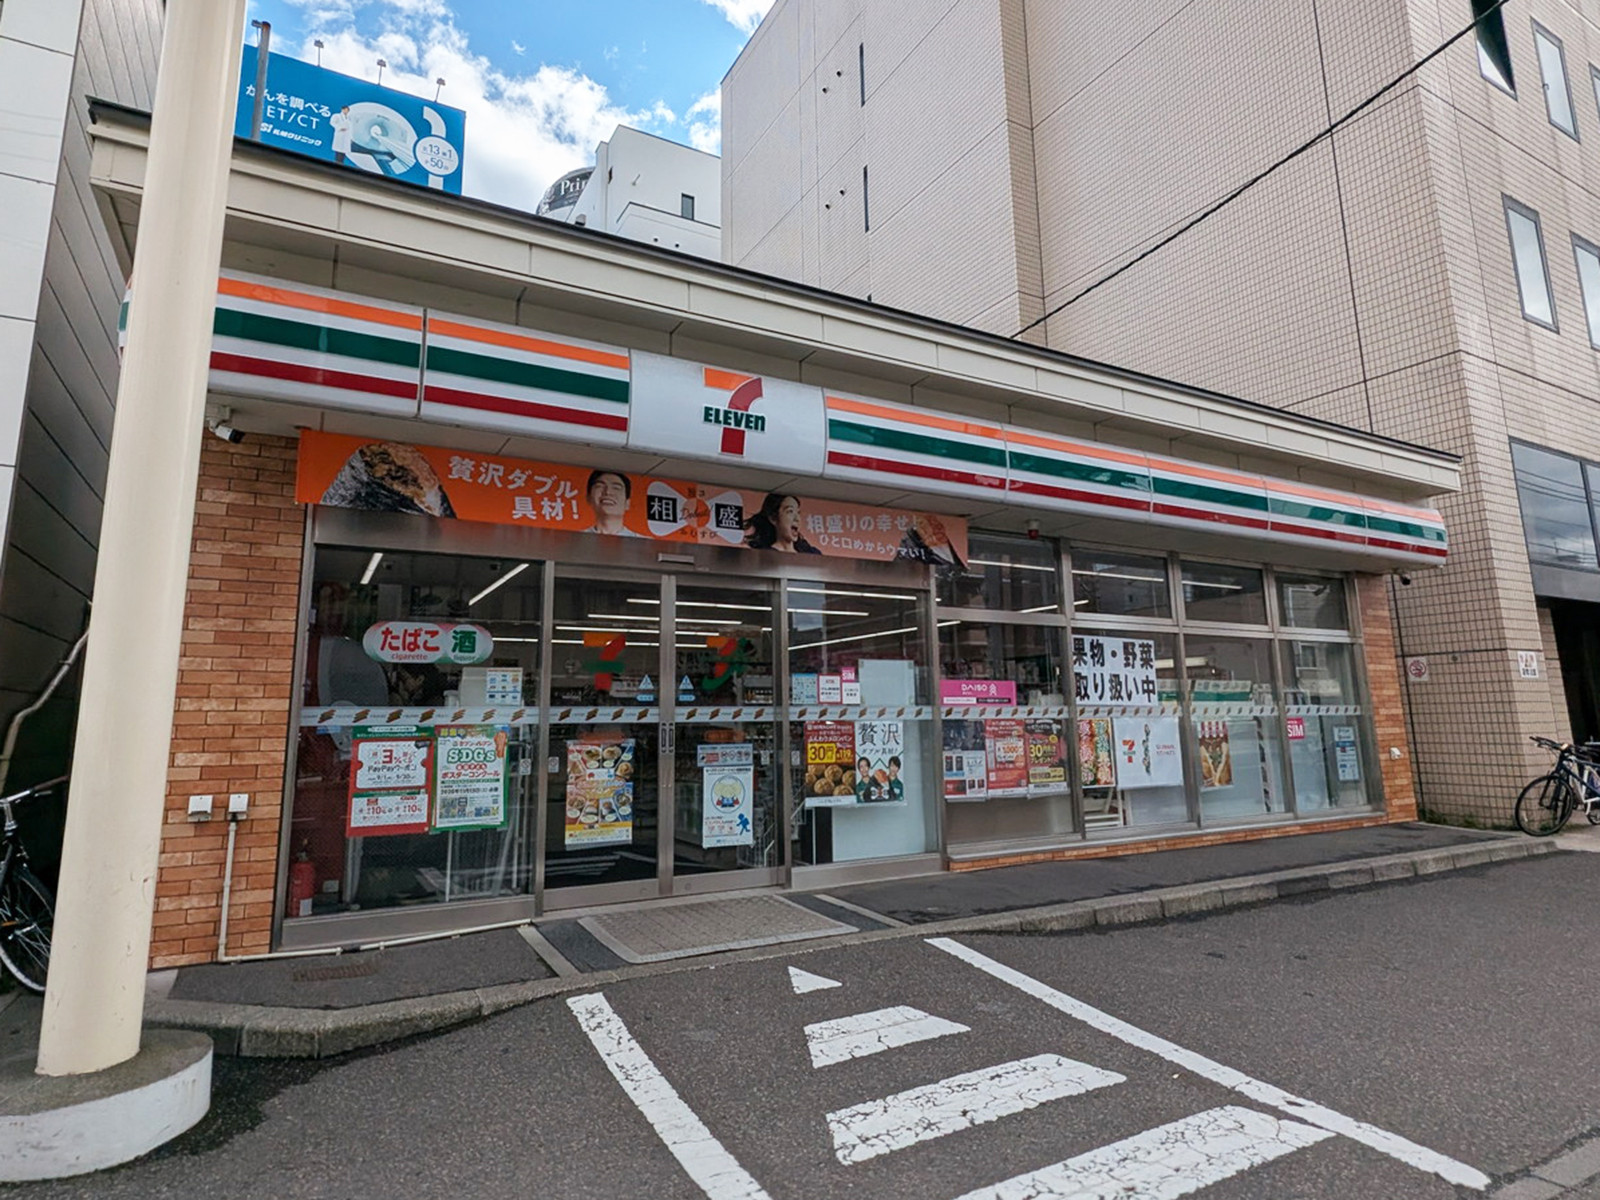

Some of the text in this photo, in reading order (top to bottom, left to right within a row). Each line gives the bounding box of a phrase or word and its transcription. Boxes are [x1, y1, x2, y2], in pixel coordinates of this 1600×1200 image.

[265, 104, 320, 130] ET/CT
[447, 455, 579, 500] 贅沢ダブル
[511, 496, 579, 521] 具材!
[649, 497, 675, 521] 相
[718, 505, 742, 528] 盛
[379, 627, 441, 652] たばこ
[451, 629, 478, 654] 酒
[391, 652, 429, 661] cigarette
[1072, 637, 1154, 671] 果物・野菜
[961, 683, 988, 692] DAISO
[1074, 671, 1156, 703] 取り扱い中
[858, 722, 900, 747] 贅沢
[1286, 724, 1304, 738] SIM
[447, 747, 497, 764] SDGs
[441, 770, 501, 779] ポスターコンクール
